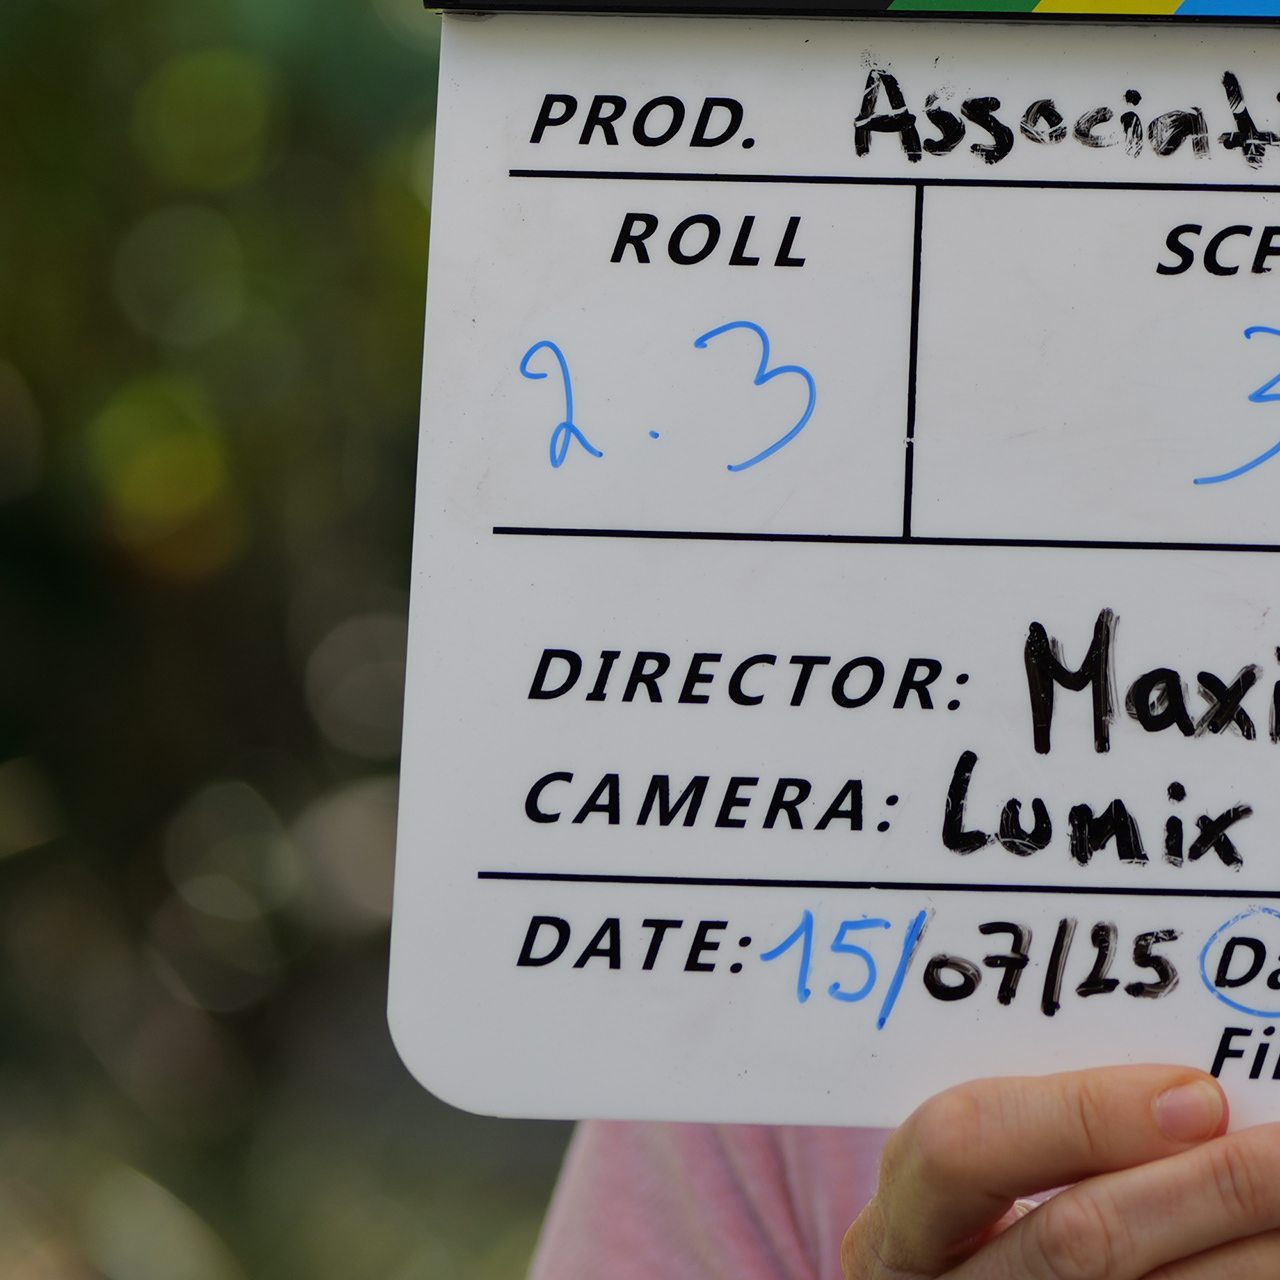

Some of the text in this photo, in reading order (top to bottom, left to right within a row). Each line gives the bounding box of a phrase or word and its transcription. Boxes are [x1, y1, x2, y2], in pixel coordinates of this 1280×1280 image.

[529, 93, 755, 150] PROD.
[609, 212, 806, 268] ROLL
[527, 648, 970, 711] DIRECTOR:
[524, 771, 899, 833] CAMERA:
[941, 749, 1253, 871] Lumix
[516, 915, 752, 974] DATE:
[759, 909, 1179, 1031] 15/07/25
